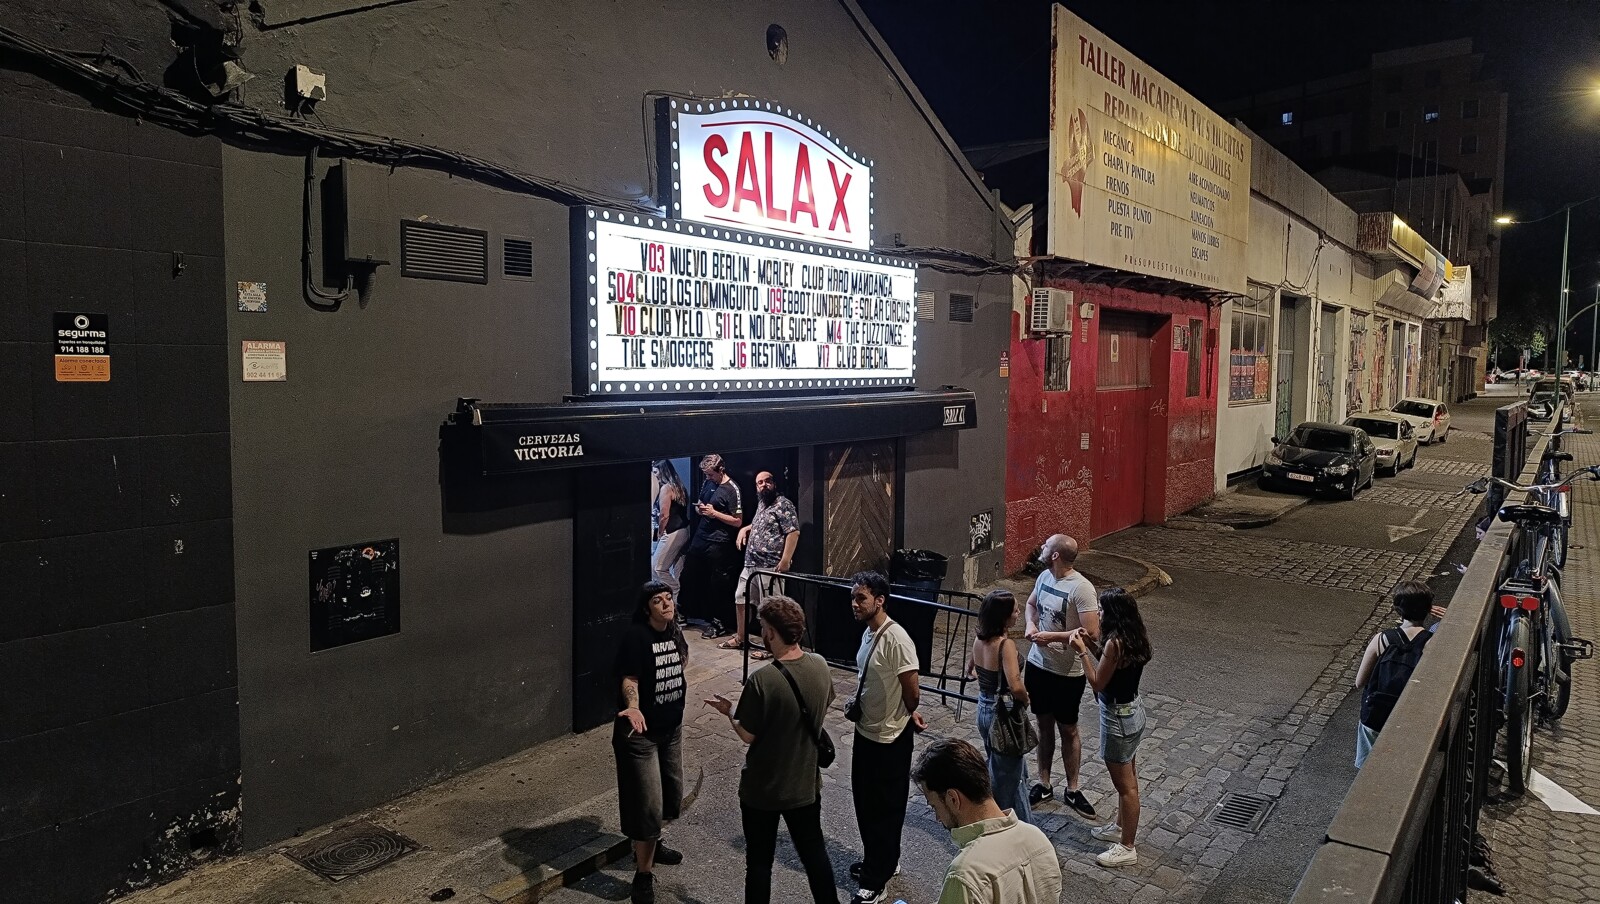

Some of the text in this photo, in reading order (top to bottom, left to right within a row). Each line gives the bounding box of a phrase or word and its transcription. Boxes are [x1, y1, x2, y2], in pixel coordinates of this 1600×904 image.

[1079, 34, 1126, 90] TALLER
[1130, 69, 1188, 128] MACARENA
[1191, 109, 1210, 141] TRES
[1213, 123, 1244, 162] HUERTAS
[1103, 128, 1135, 156] MECÁNICA
[702, 131, 852, 233] SALA X
[1104, 152, 1124, 174] CHAPA
[1126, 160, 1130, 174] Y
[1132, 164, 1156, 186] PINTURA
[1188, 171, 1198, 186] AIRE
[1106, 176, 1130, 196] FRENOS
[1108, 199, 1152, 225] PUESTA PUNTO
[1110, 221, 1134, 240] PRE ITV
[640, 242, 664, 272] V03
[670, 246, 707, 278] NUEVO
[712, 252, 750, 282] BERLIN
[758, 258, 794, 288] MORLEY
[802, 264, 824, 290] CLUB
[1192, 246, 1209, 262] ESCAPES
[670, 278, 692, 306] LOS
[695, 280, 758, 311] DOMINGUITO
[860, 298, 884, 322] SOLAR
[886, 300, 910, 324] CIRCUS
[58, 330, 106, 339] segurma
[614, 304, 636, 336] V10
[640, 306, 672, 336] CLUB
[676, 309, 703, 338] YELO
[734, 313, 744, 340] EL
[750, 314, 764, 340] NOI
[770, 315, 786, 340] DEL
[788, 317, 816, 342] SUCRE
[846, 321, 860, 345] THE
[862, 322, 902, 346] FUZZTONES
[622, 338, 646, 368] THE
[651, 340, 714, 368] SMOGGERS
[730, 342, 746, 368] J16
[750, 343, 797, 368] RESTINGA
[817, 344, 830, 368] V17
[860, 346, 888, 368] BRECHA
[514, 445, 584, 460] VICTORIA
[518, 434, 580, 446] CERVEZAS
